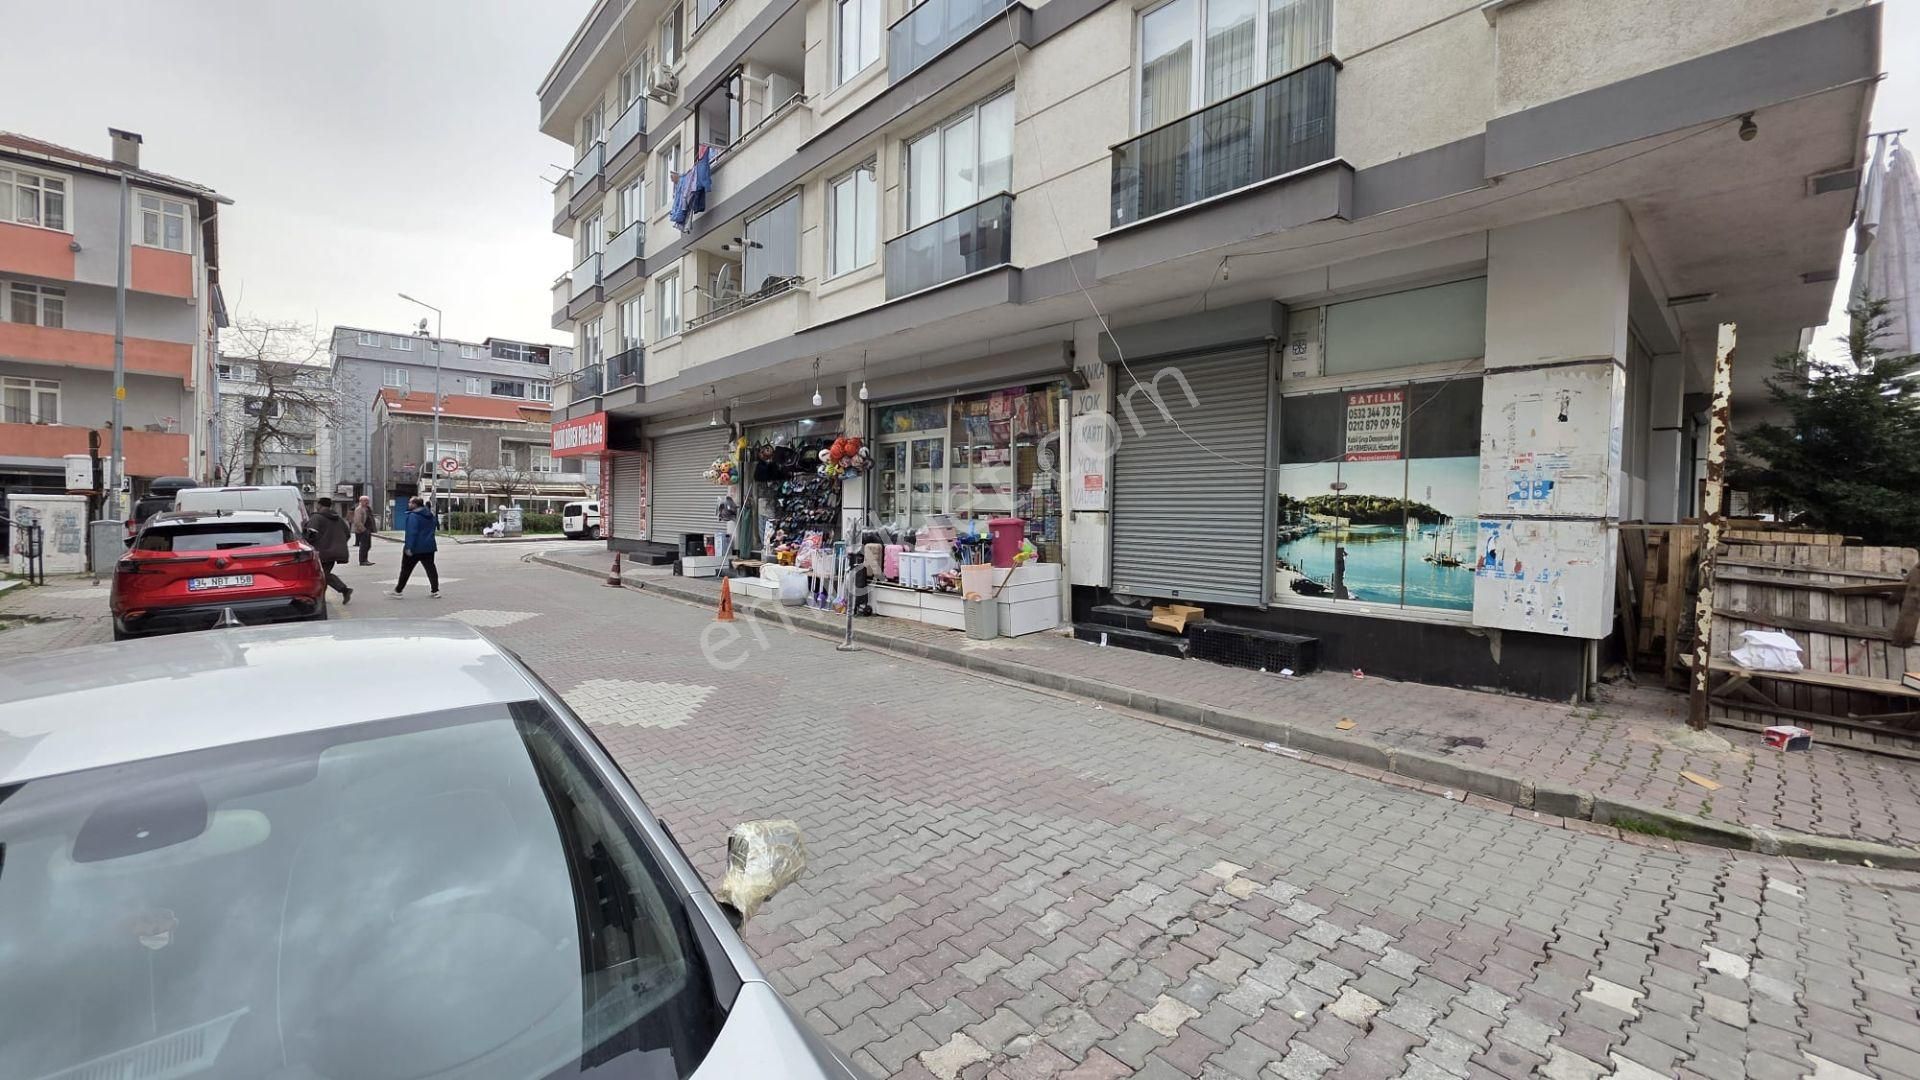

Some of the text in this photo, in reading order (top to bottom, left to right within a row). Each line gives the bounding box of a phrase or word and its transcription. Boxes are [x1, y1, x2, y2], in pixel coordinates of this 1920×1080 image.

[1080, 394, 1100, 413] YOK
[1349, 391, 1400, 405] SATILIK
[1348, 405, 1400, 419] 0532 344 78 72
[1348, 420, 1364, 431] 0212
[1380, 419, 1390, 430] 09
[1391, 418, 1400, 429] 96
